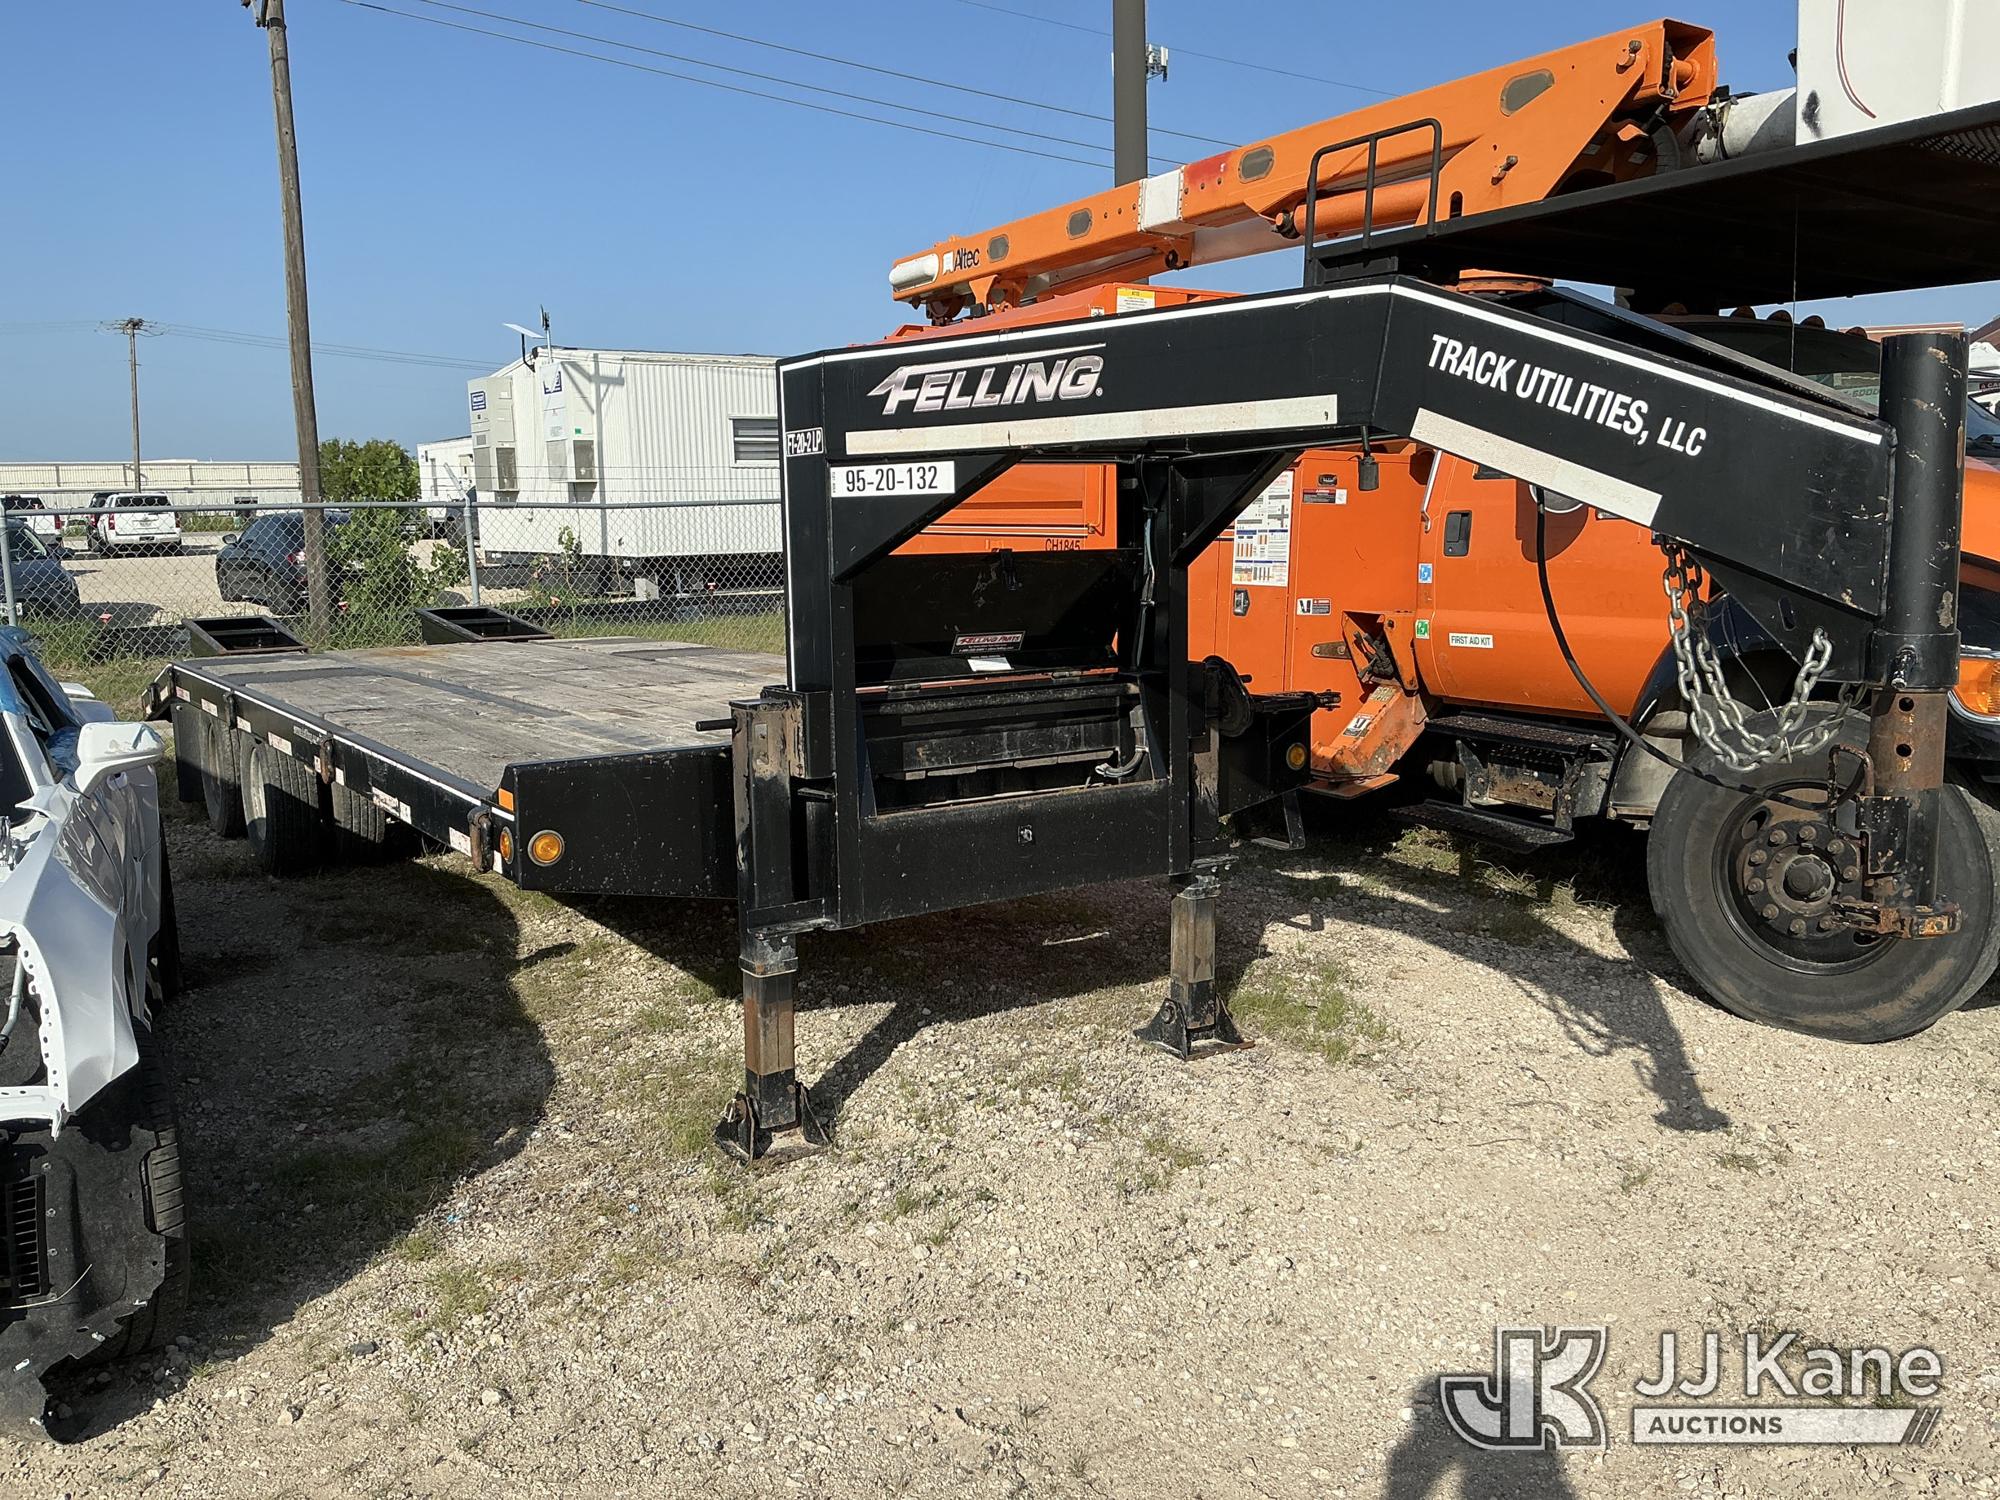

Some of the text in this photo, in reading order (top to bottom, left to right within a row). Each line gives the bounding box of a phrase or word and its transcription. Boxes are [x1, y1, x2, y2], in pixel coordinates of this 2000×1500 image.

[954, 247, 980, 271] Altec
[867, 343, 1107, 416] FELLING
[1428, 334, 1707, 457] TRACK UTILITIES, LLC
[845, 465, 938, 493] 95-20-132
[1045, 538, 1081, 551] CH1845
[1451, 635, 1491, 646] FIRST AID KIT
